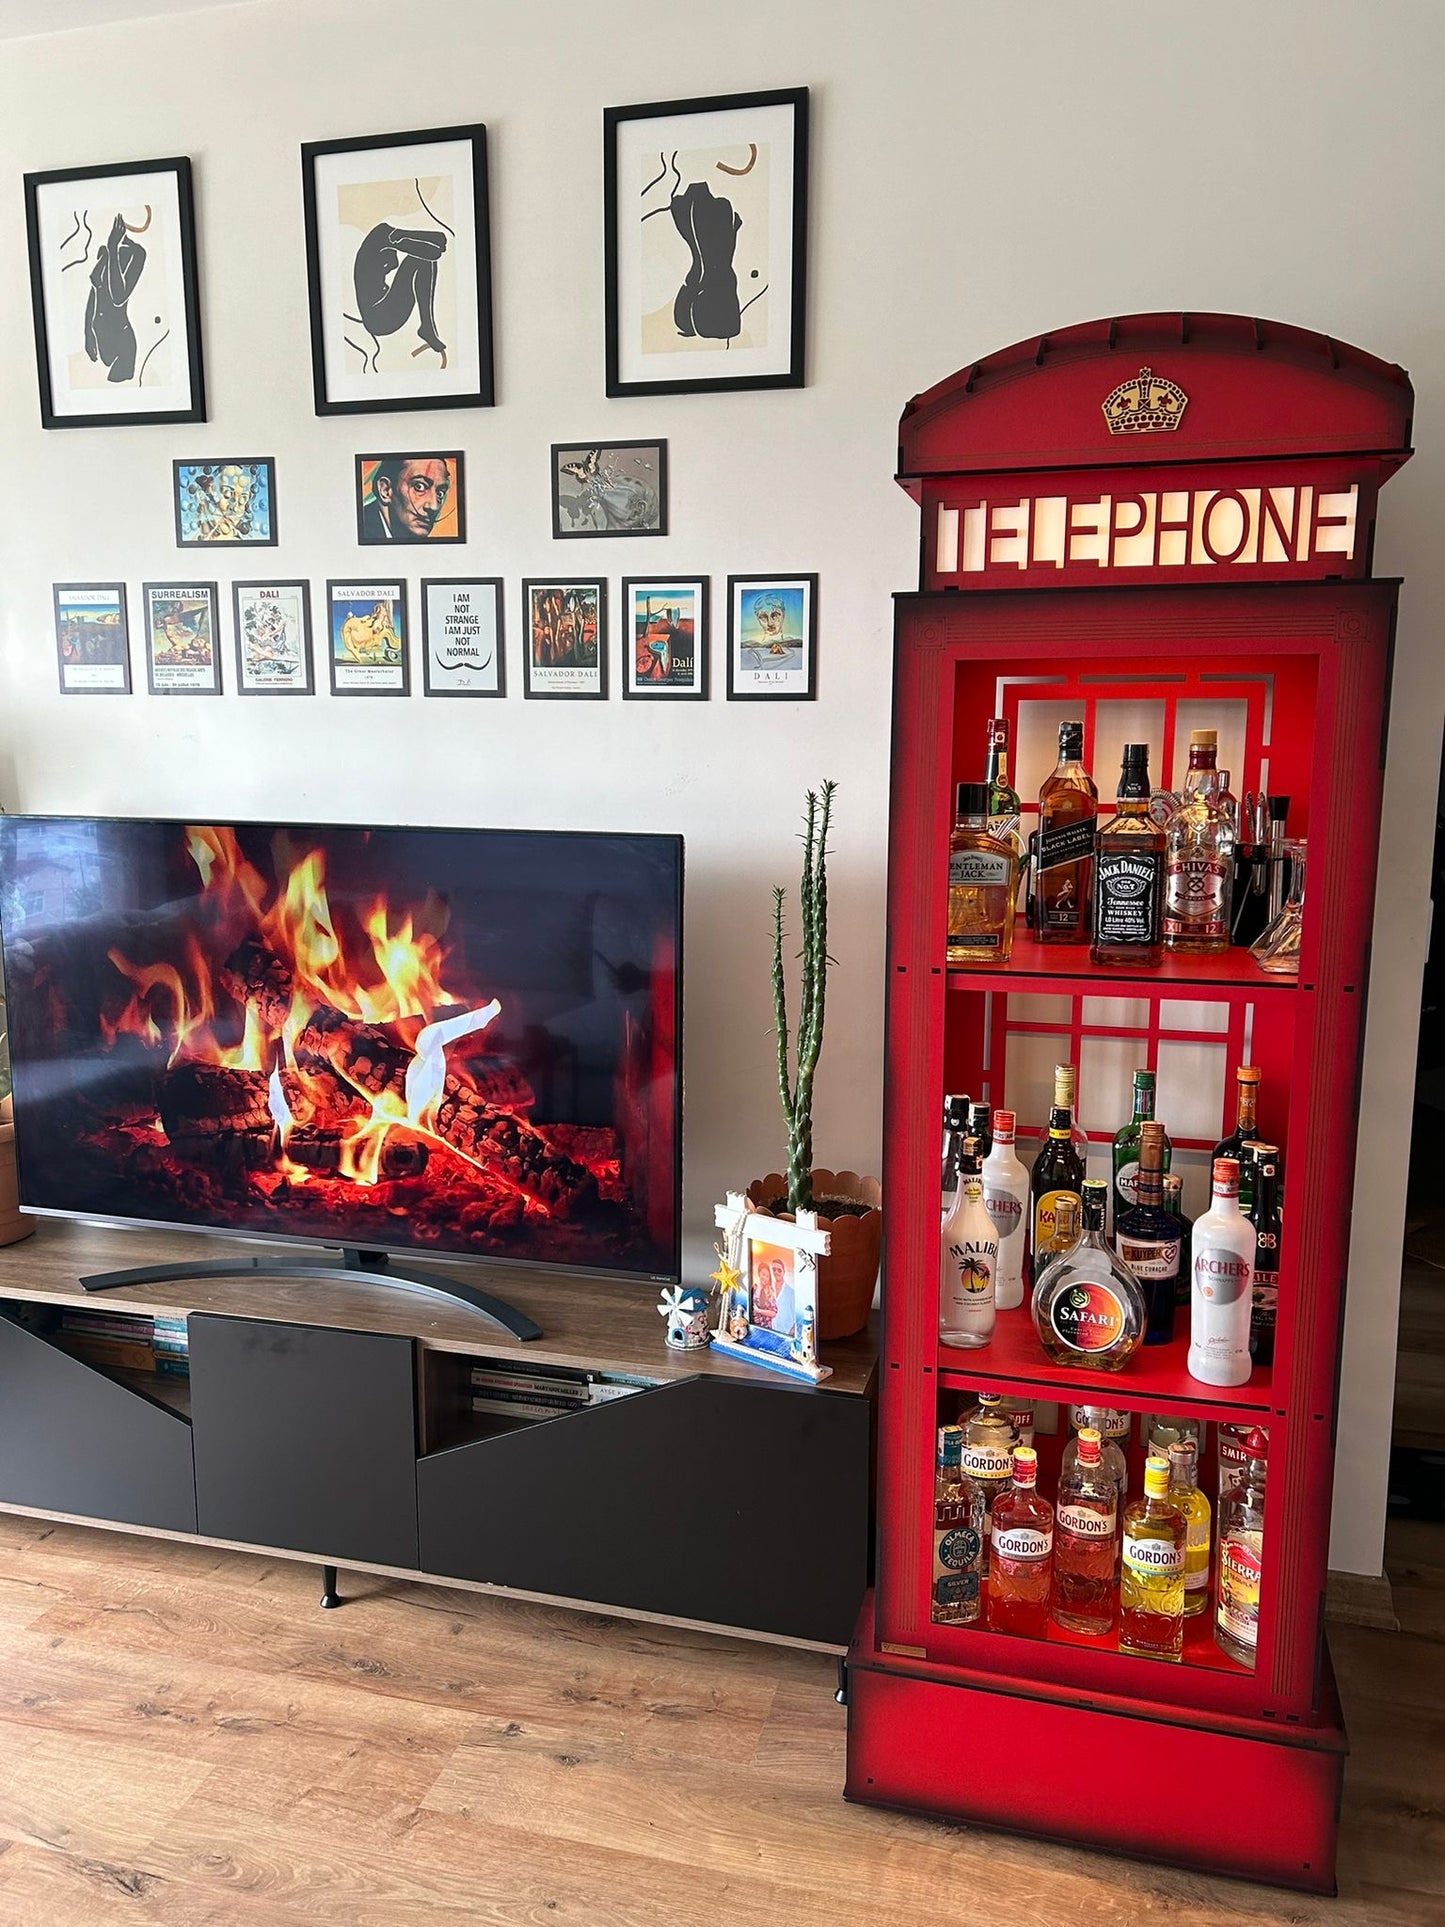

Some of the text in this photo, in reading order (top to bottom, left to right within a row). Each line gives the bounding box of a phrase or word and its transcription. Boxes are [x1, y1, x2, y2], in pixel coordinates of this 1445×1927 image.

[941, 485, 1356, 571] TELEPHONE
[151, 590, 208, 599] SURREALISM
[259, 590, 280, 599] DALI
[453, 593, 470, 602] I AM
[454, 604, 470, 613] NOT
[445, 615, 479, 624] STRANGE
[444, 626, 480, 635] I AM JUST
[455, 637, 471, 646] NOT
[446, 648, 480, 657] NORMAL
[577, 670, 597, 678] DALI
[1041, 841, 1066, 852] BLACK
[1067, 833, 1091, 844] LABEL
[949, 862, 1003, 870] ENTLEMAN
[1099, 864, 1121, 880] JACK
[1173, 862, 1221, 873] CHIVAS
[960, 870, 985, 878] JACK
[1107, 897, 1144, 906] Tennessee
[1059, 913, 1069, 921] 12
[1205, 924, 1217, 933] 12
[986, 1199, 1023, 1215] CHERS
[949, 1241, 998, 1259] MALIBU
[1195, 1256, 1250, 1277] ARCHERS
[1060, 1306, 1115, 1327] SAFARI
[1222, 1445, 1247, 1461] SMIR
[963, 1453, 1014, 1471] GORDON'S
[1059, 1510, 1108, 1532] GORDON'S
[945, 1530, 975, 1546] OLMECA
[998, 1535, 1049, 1553] GORDON'S
[944, 1551, 976, 1567] TEQUILA
[1129, 1545, 1182, 1565] GORDON'S
[1221, 1549, 1261, 1582] SIERRA
